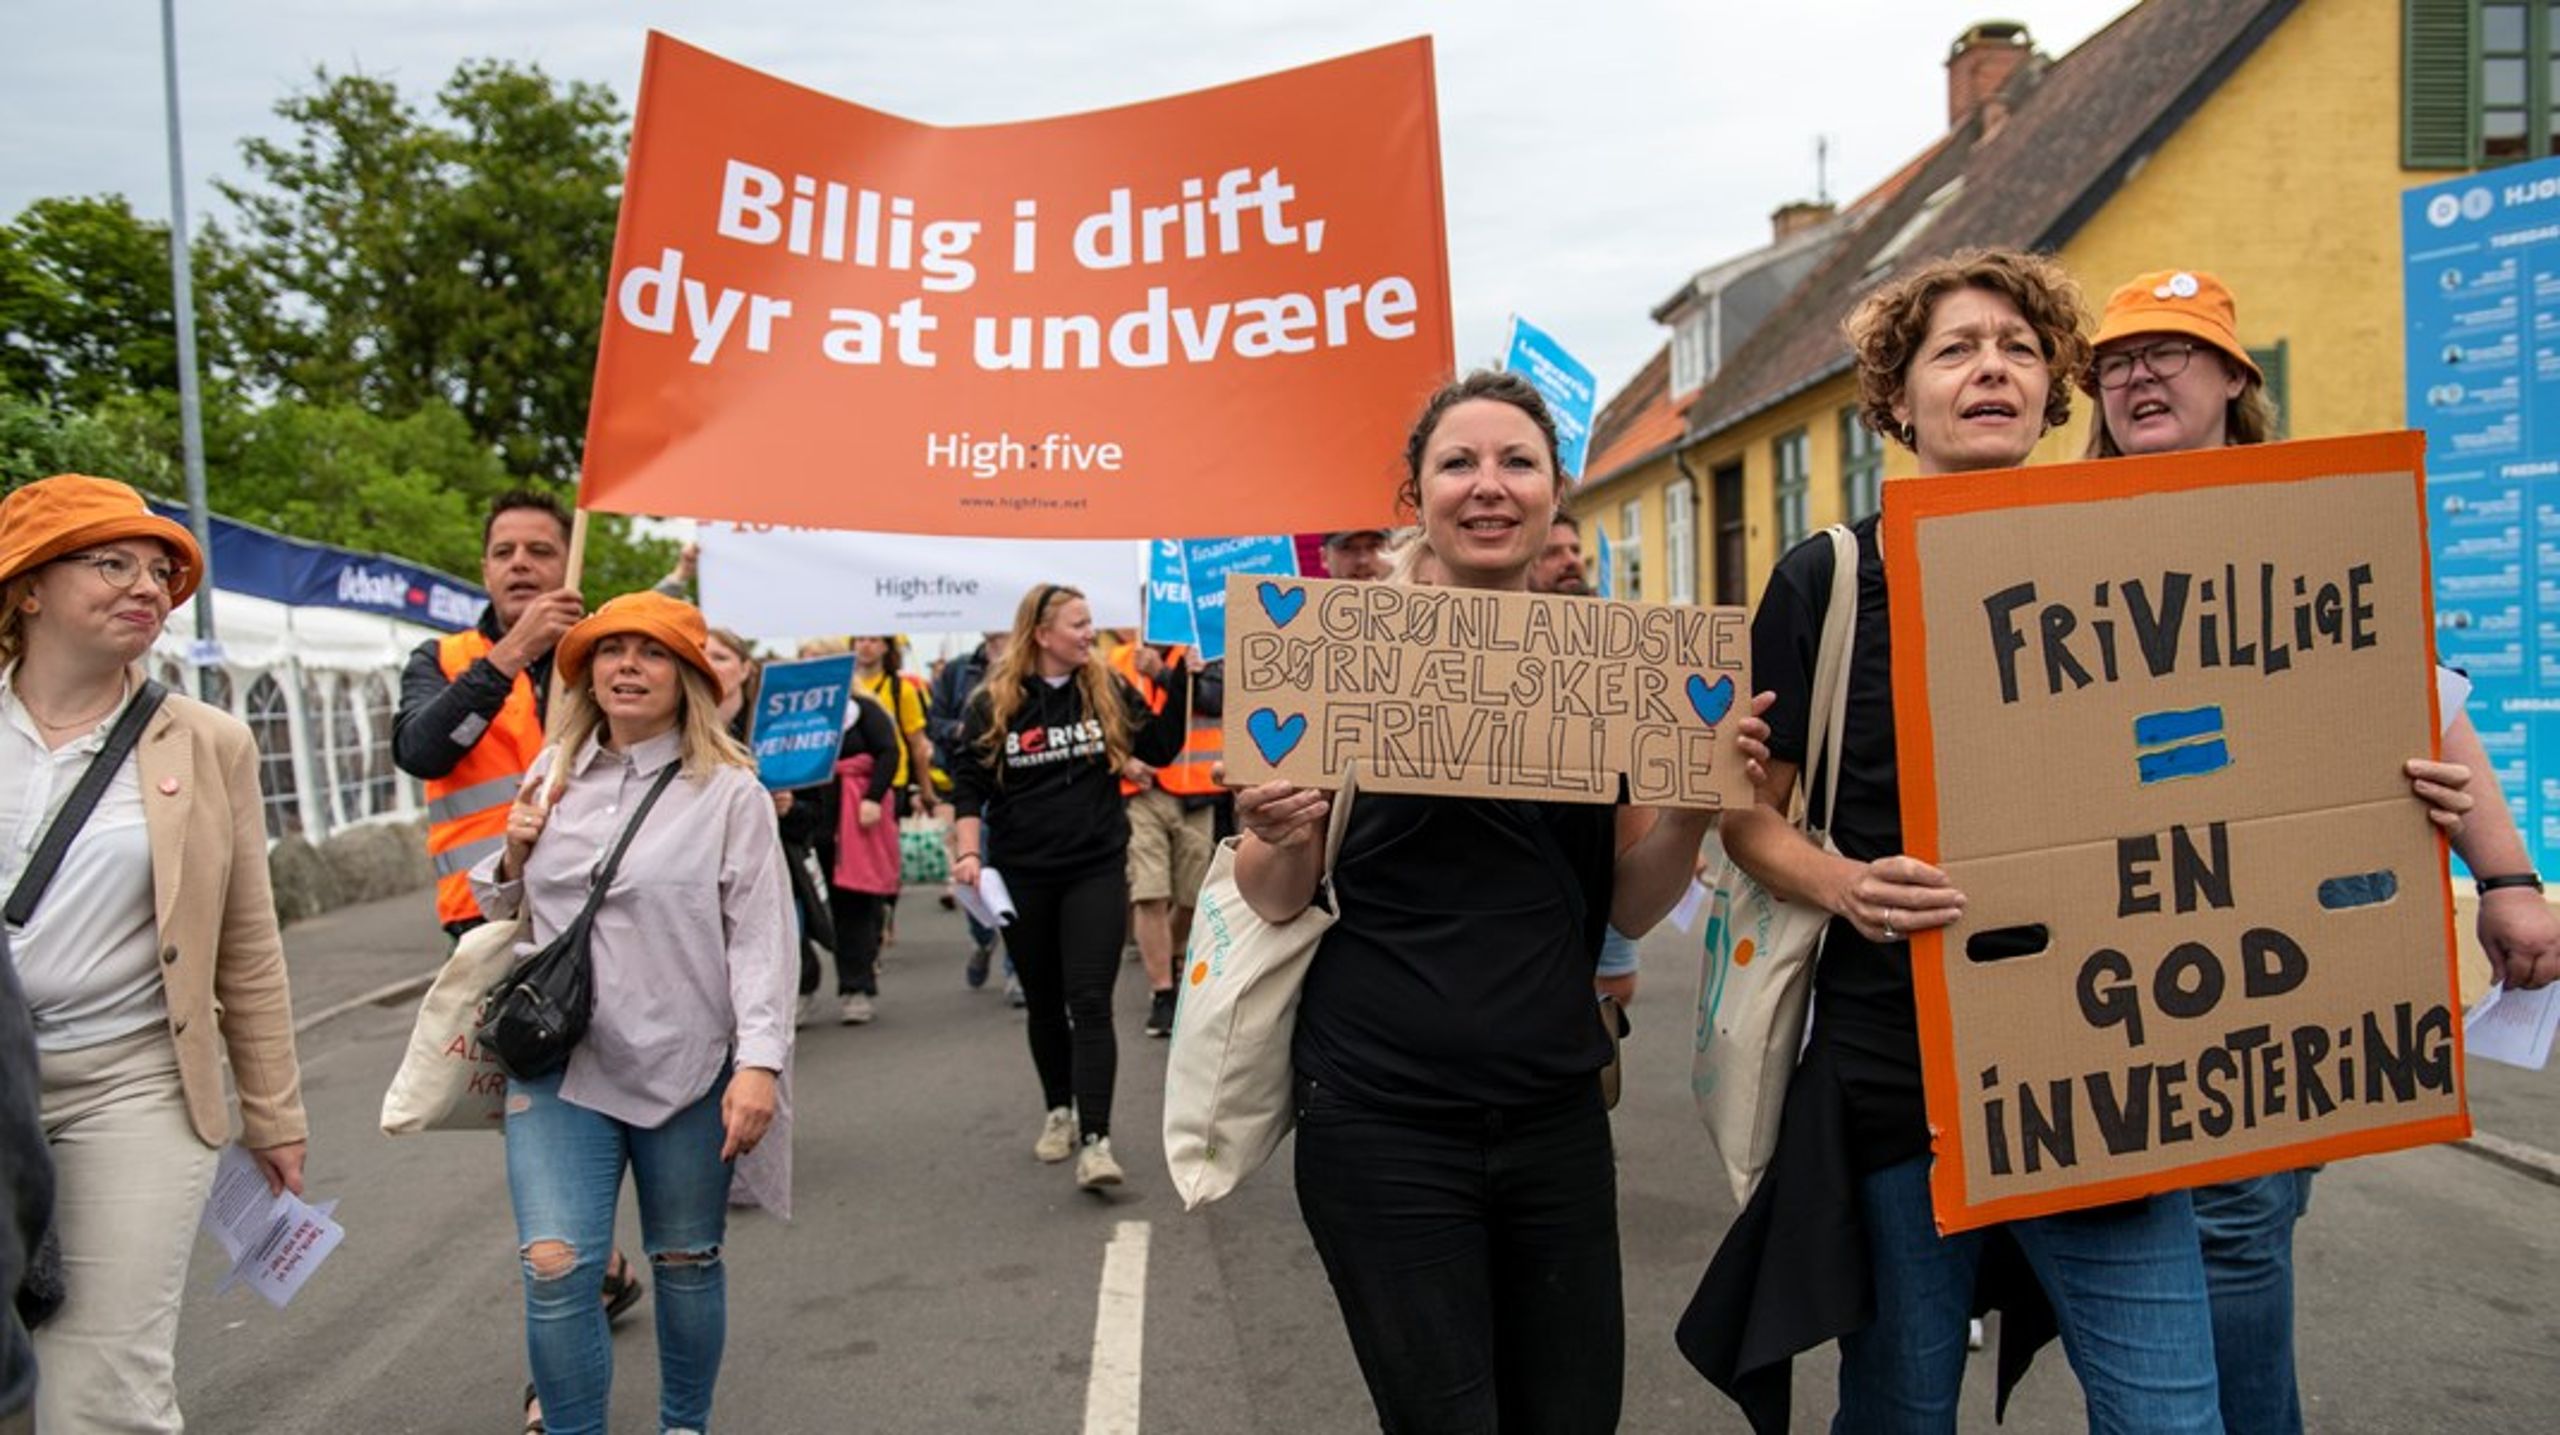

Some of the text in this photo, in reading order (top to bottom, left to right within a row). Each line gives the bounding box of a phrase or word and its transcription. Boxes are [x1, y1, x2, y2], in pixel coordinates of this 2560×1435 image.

[717, 158, 1326, 292] Billig i drift,
[617, 248, 1418, 370] dyr at undvære
[926, 432, 1123, 478] High:five
[875, 576, 979, 601] High:five
[1319, 585, 1745, 670] GRØNLANDSKE
[767, 684, 842, 716] STØT
[1241, 631, 1679, 723] BØRN ÆLSKER
[2116, 821, 2235, 918] EN
[2076, 927, 2309, 1048] GOD
